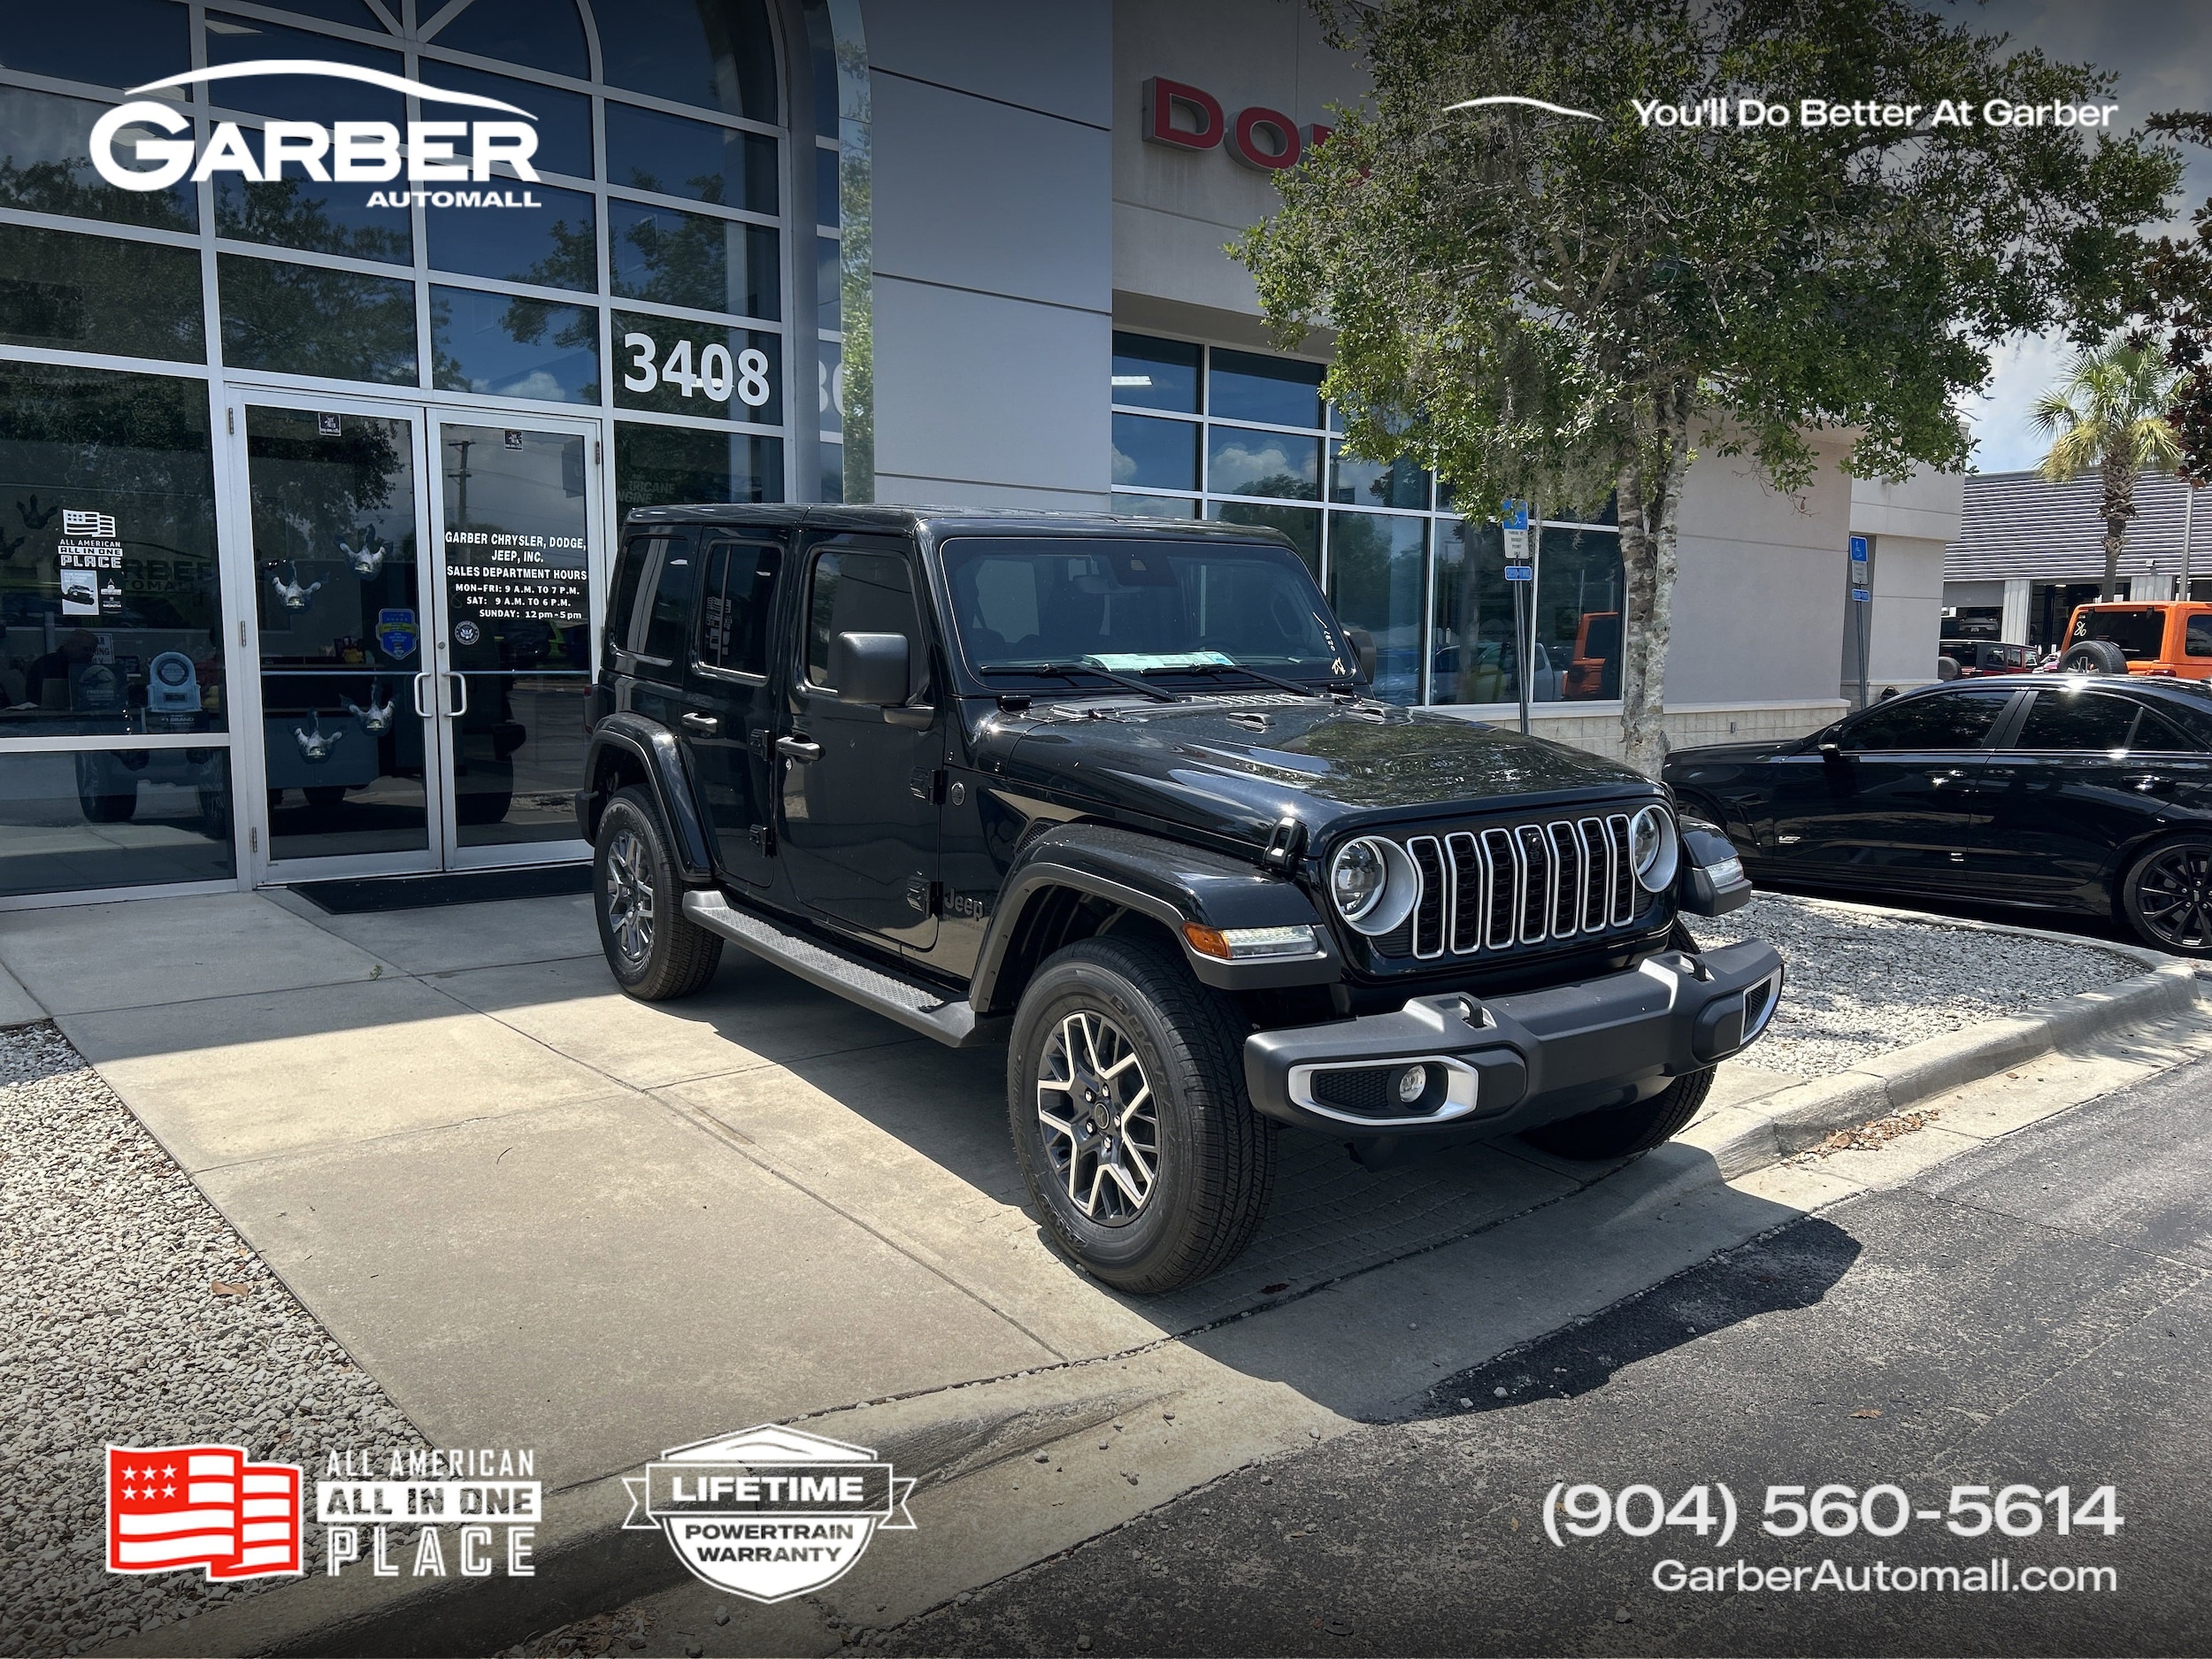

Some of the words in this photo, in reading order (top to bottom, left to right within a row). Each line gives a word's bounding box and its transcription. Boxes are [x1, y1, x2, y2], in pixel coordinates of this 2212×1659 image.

[624, 332, 770, 407] 3408
[59, 537, 75, 546] ALL
[77, 538, 121, 549] AMERICAN
[445, 531, 488, 545] GARBER
[491, 533, 547, 549] CHRYSLER,
[549, 535, 587, 551] DODGE,
[60, 554, 122, 569] PLACE
[491, 549, 521, 564] JEEP,
[523, 550, 544, 563] INC.
[447, 565, 480, 577] SALES
[482, 566, 550, 580] DEPARTMENT
[553, 569, 588, 580] HOURS
[455, 583, 503, 594] MON-FRI:
[504, 584, 511, 594] 9
[513, 585, 535, 595] A.M.
[537, 585, 549, 595] TO
[551, 586, 557, 595] 7
[559, 586, 580, 595] P.M.
[466, 595, 488, 605] SAT:
[495, 597, 502, 606] 9
[503, 597, 526, 607] A.M.
[527, 597, 540, 607] TO
[541, 598, 549, 607] 6
[550, 598, 572, 607] P.M.
[479, 609, 520, 618] SUNDAY:
[943, 887, 984, 922] Jeep
